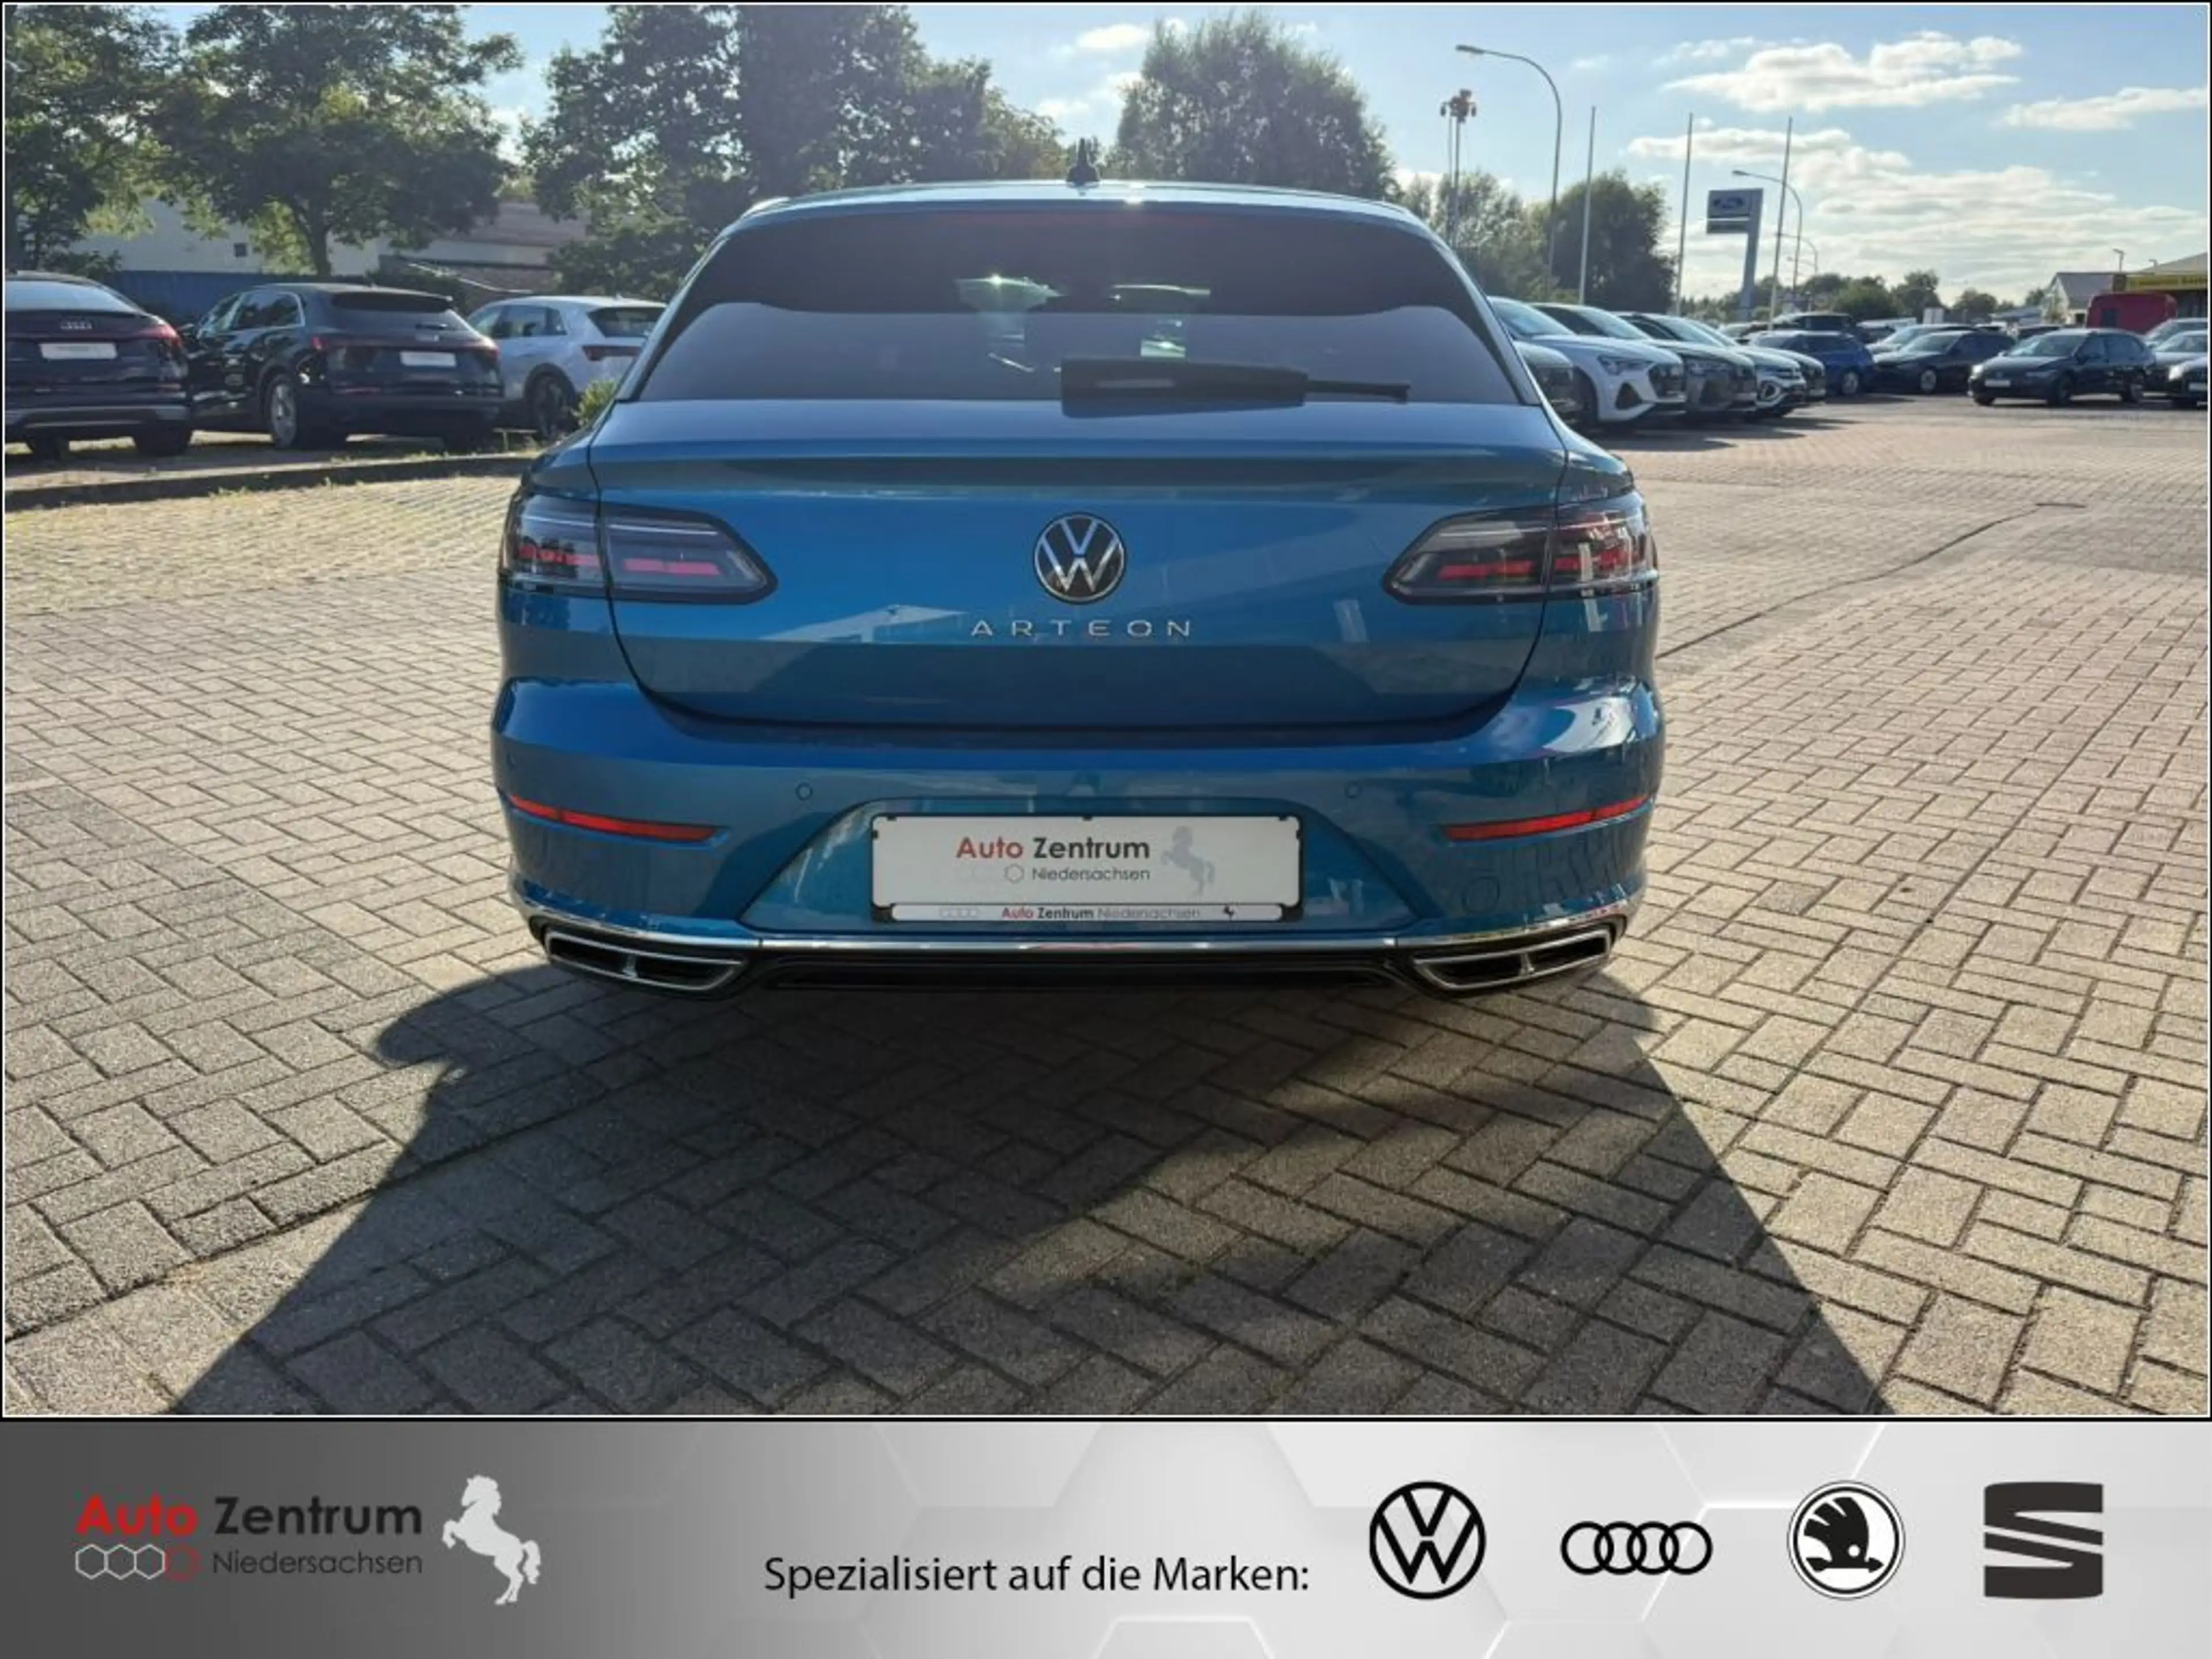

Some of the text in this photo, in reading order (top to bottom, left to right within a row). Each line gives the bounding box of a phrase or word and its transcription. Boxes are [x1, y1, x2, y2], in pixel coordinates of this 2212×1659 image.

[971, 620, 1191, 637] ARTEON
[956, 836, 1150, 858] Auto Zentrum
[1032, 867, 1150, 881] Niedersachsen
[1002, 907, 1033, 919] Auto
[1038, 907, 1093, 919] Zentrum
